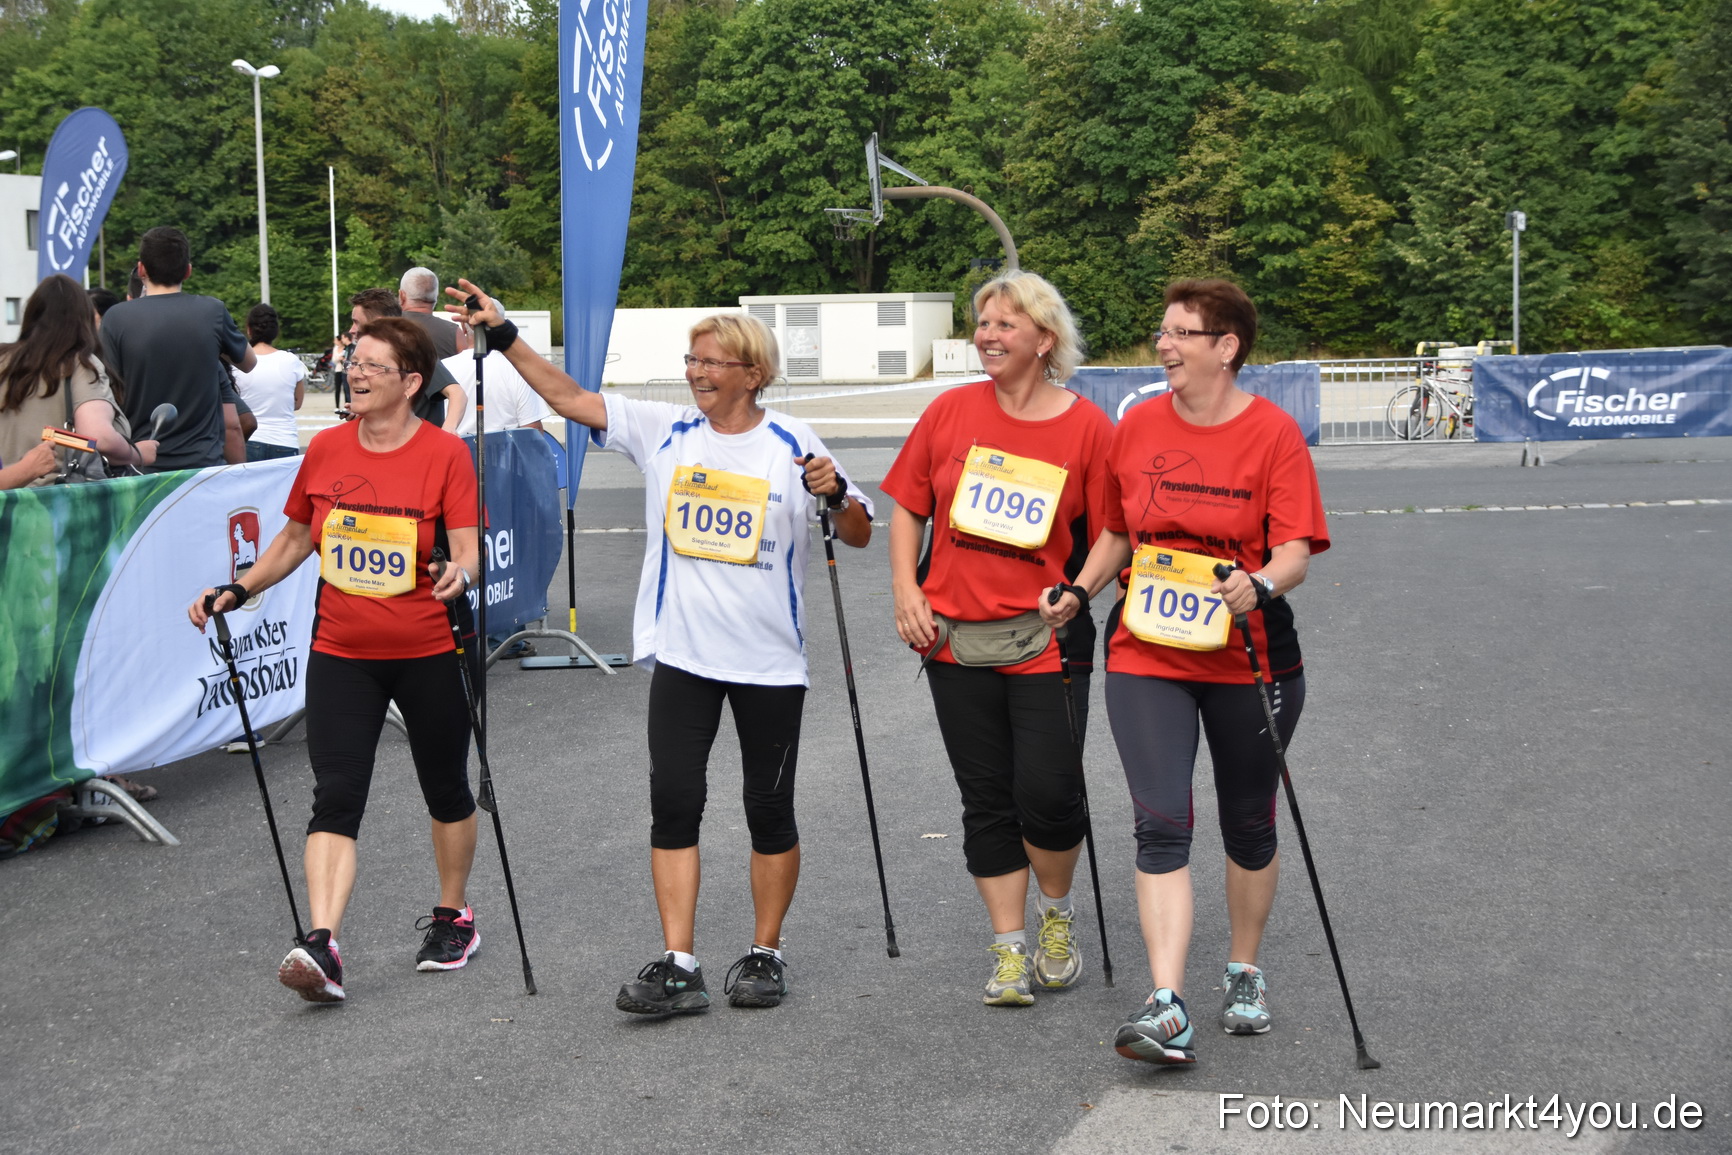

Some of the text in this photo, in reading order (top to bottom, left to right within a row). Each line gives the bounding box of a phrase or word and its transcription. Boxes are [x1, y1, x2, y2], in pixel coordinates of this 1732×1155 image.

[587, 0, 619, 129] Fisc
[615, 0, 632, 126] AUTOMO
[59, 136, 108, 250] Fischer
[76, 158, 114, 249] AUTOMOBILE
[1556, 387, 1687, 413] Fischer
[1567, 413, 1676, 427] AUTOMOBILE
[1160, 480, 1252, 501] Physiotherapie Wild
[336, 501, 424, 519] Physiotherapie Wild
[969, 482, 1046, 525] 1096
[677, 502, 753, 539] 1098
[983, 519, 1000, 529] Birgit
[1000, 521, 1013, 531] Wild
[691, 537, 718, 547] Sieglinde
[760, 539, 776, 552] fit!
[1206, 535, 1225, 549] Sie
[331, 544, 406, 577] 1099
[349, 577, 386, 587] Elfriede März
[1140, 584, 1222, 626] 1097
[1156, 623, 1192, 636] Ingrid Plank
